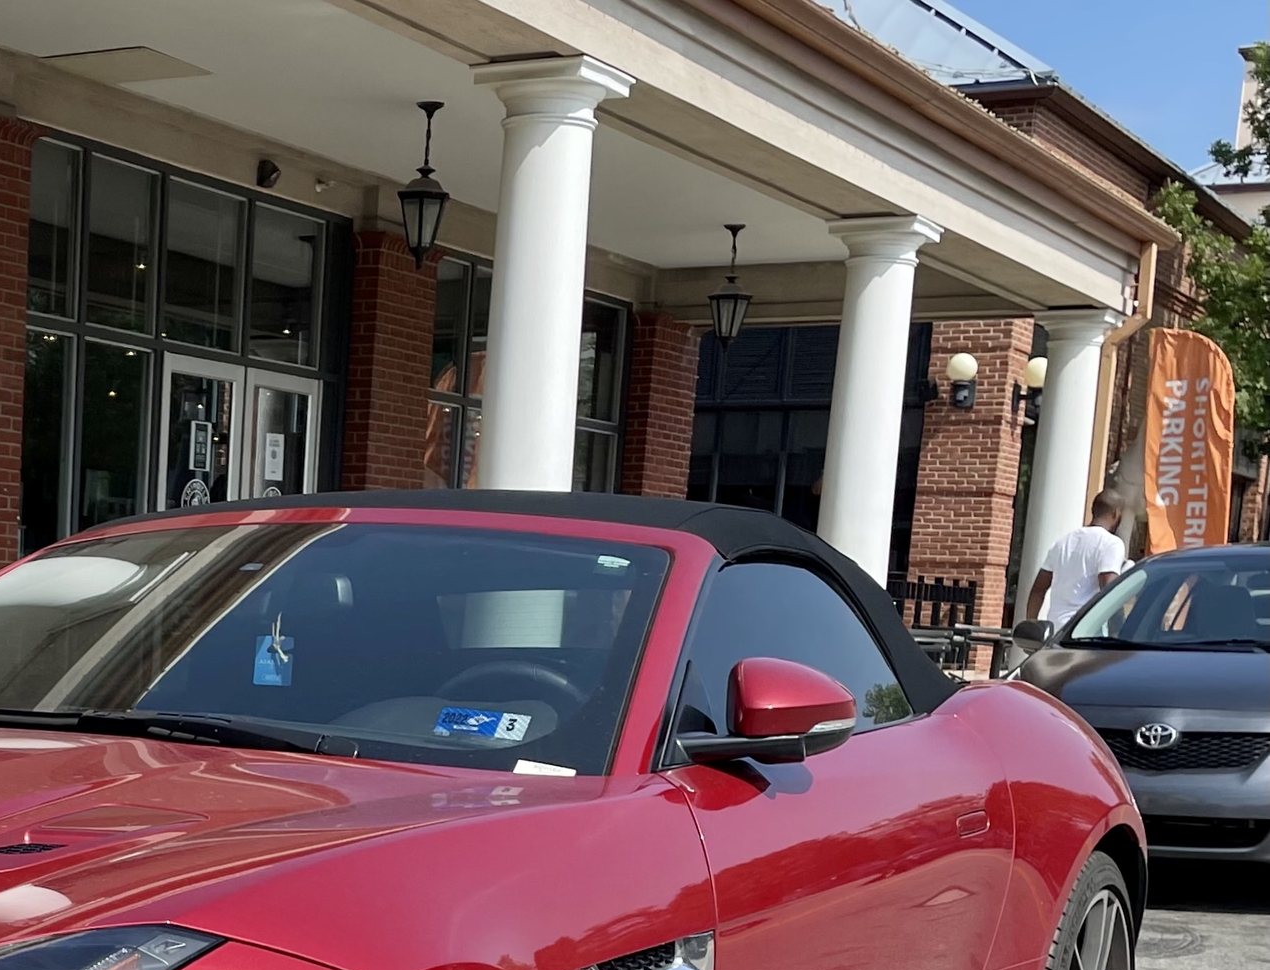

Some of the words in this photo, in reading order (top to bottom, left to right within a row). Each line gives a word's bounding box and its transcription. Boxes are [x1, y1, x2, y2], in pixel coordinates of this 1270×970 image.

[1157, 379, 1188, 507] PARKING
[441, 712, 469, 724] 2022
[505, 718, 517, 731] 3
